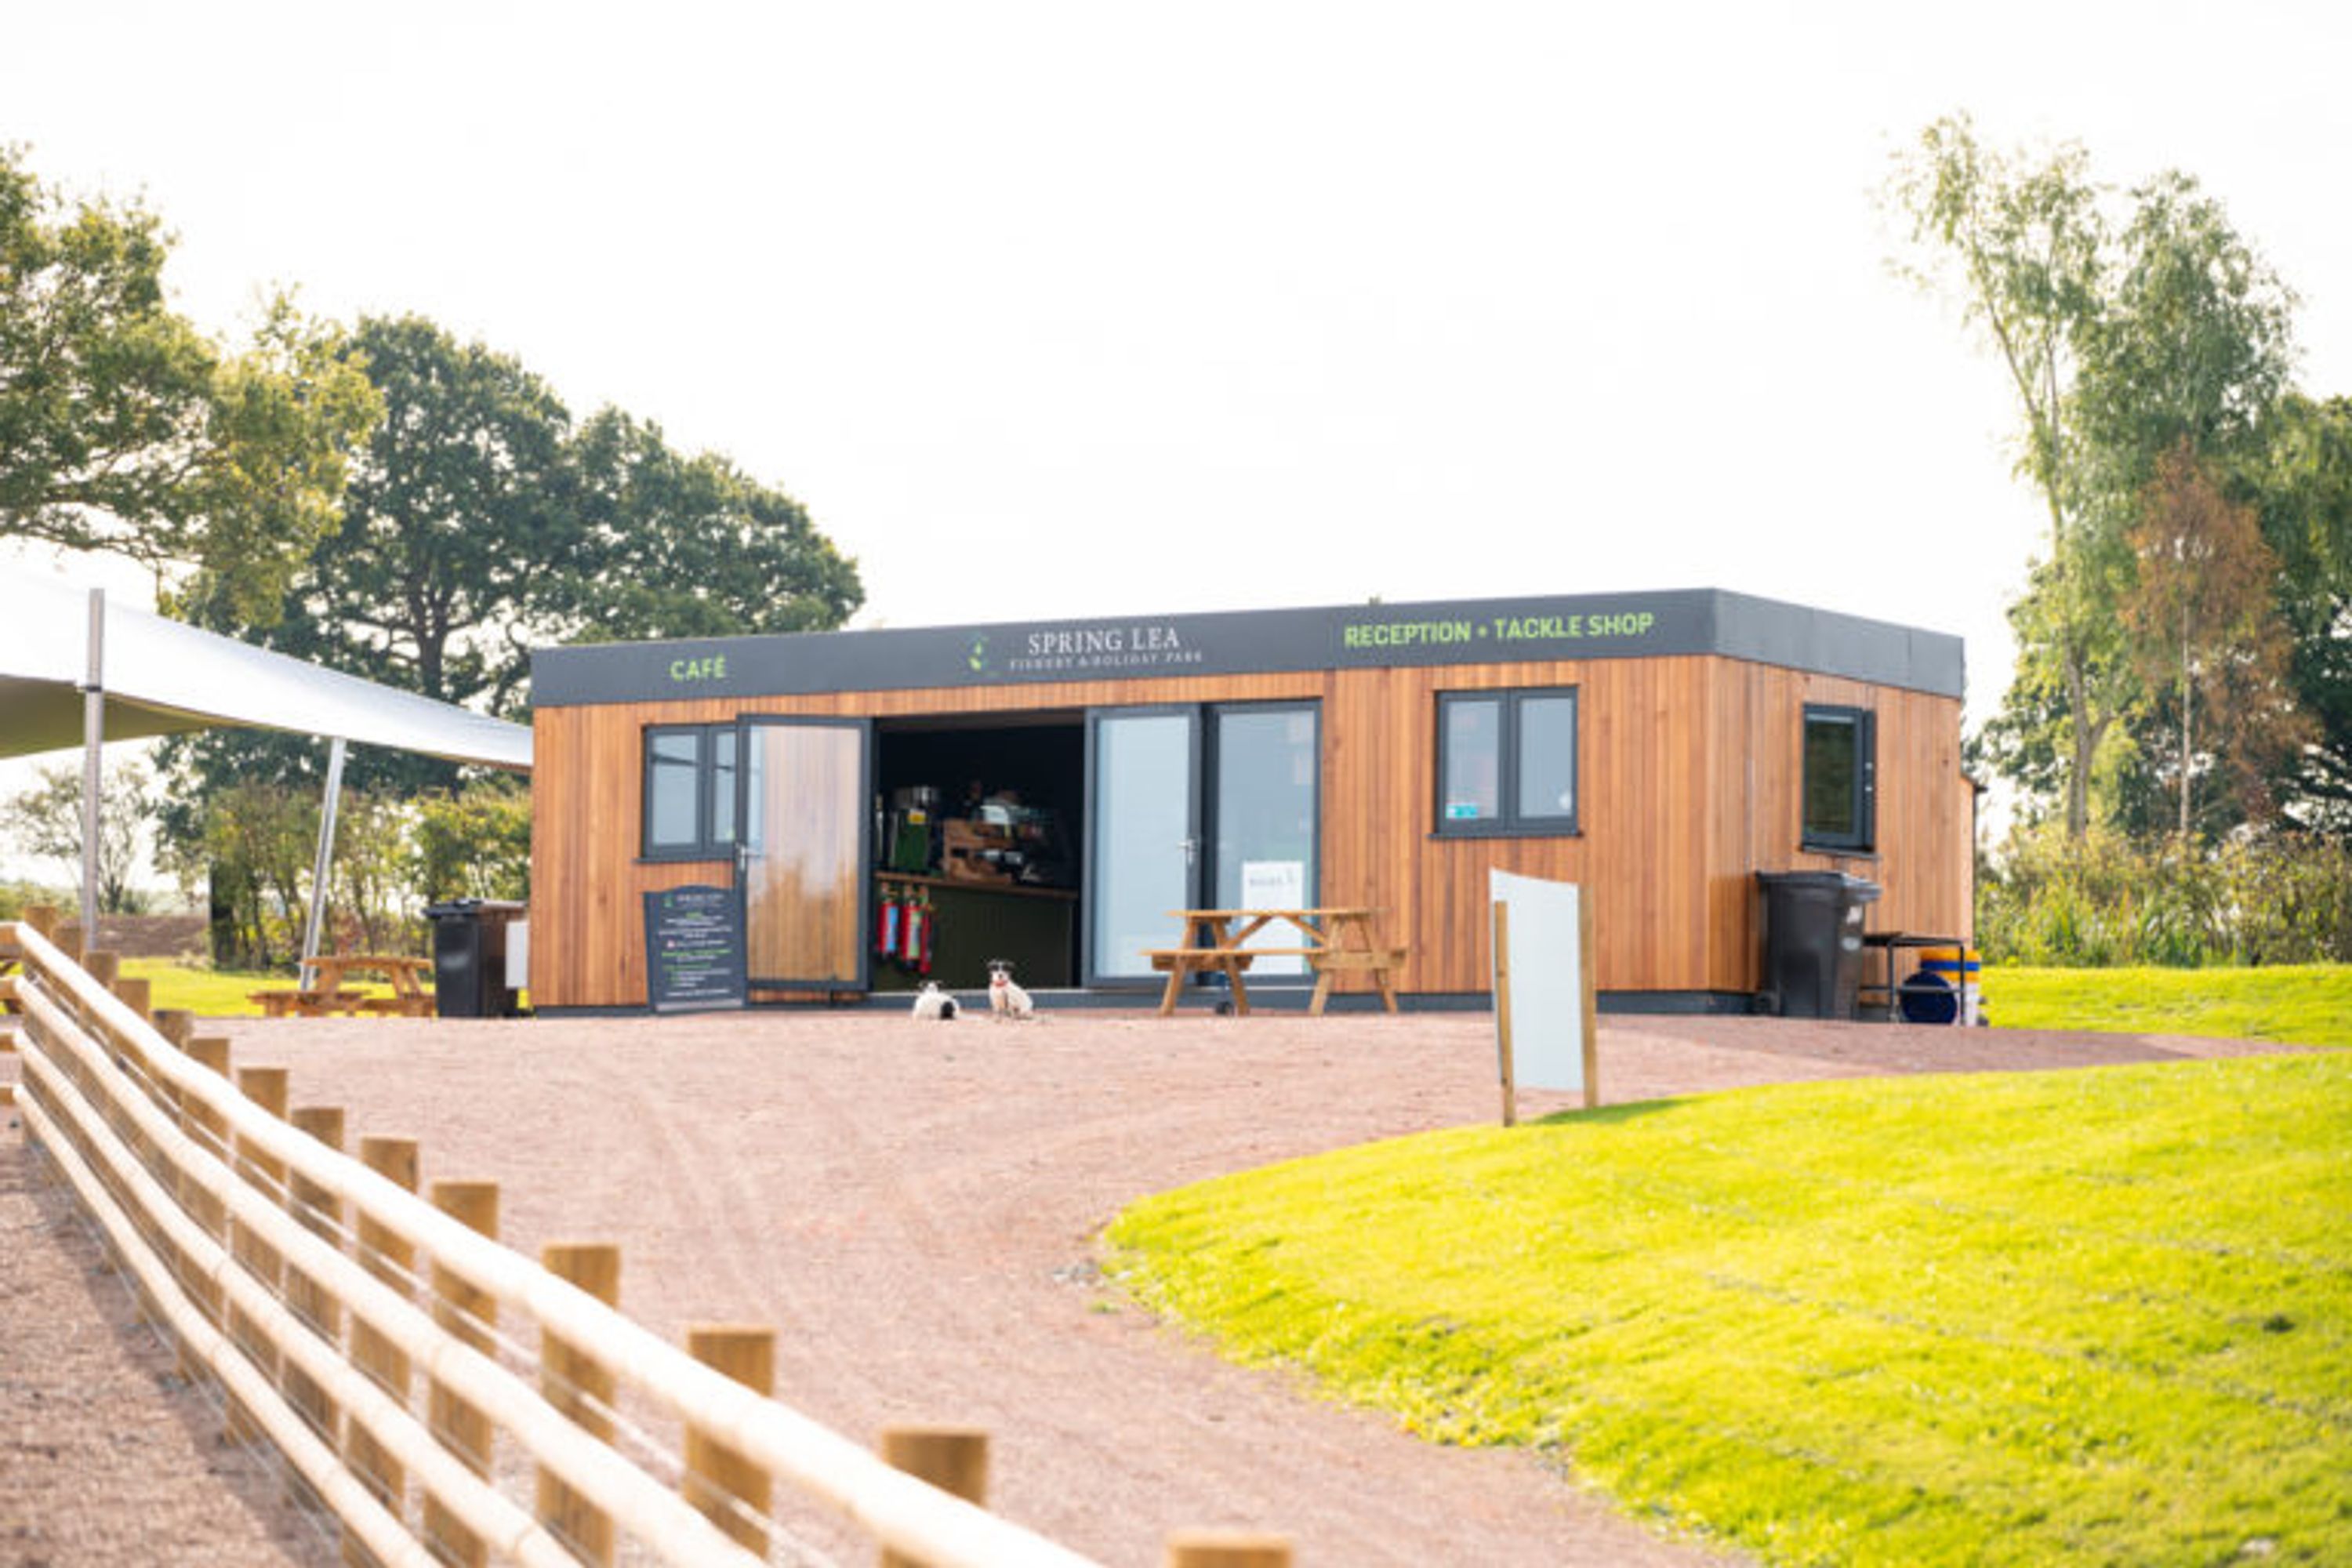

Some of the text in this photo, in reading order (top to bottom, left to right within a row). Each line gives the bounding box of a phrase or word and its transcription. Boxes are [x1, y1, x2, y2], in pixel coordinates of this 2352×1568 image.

[1028, 626, 1179, 655] SPRING LEA
[1345, 612, 1653, 648] RECEPTION TACKLE SHOP
[1092, 652, 1157, 666] HOLIDAY
[1167, 650, 1202, 663] PARK
